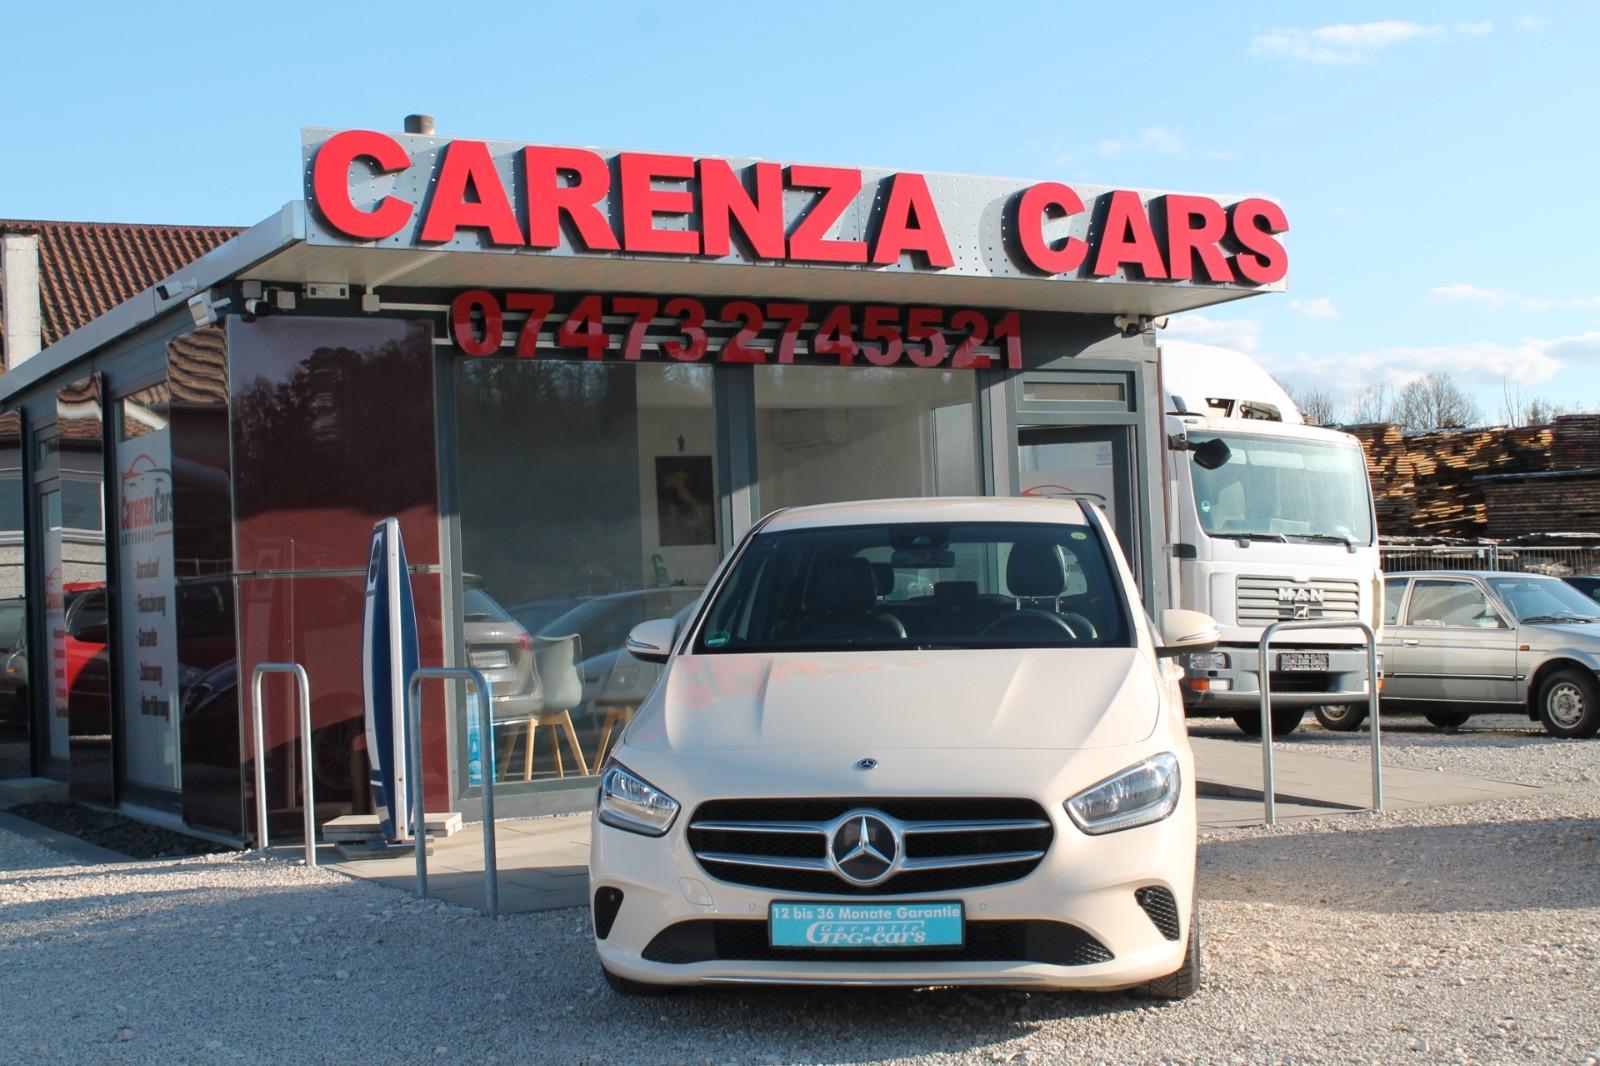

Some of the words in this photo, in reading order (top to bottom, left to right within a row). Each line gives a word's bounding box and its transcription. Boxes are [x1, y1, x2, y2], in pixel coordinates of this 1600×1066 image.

[312, 130, 956, 269] CARENZA
[1017, 181, 1290, 285] CARS
[1278, 587, 1325, 602] MAN
[773, 907, 790, 920] 12
[793, 907, 813, 920] bis
[817, 907, 834, 920] 36
[838, 907, 892, 920] Monate
[896, 906, 961, 919] Garantie
